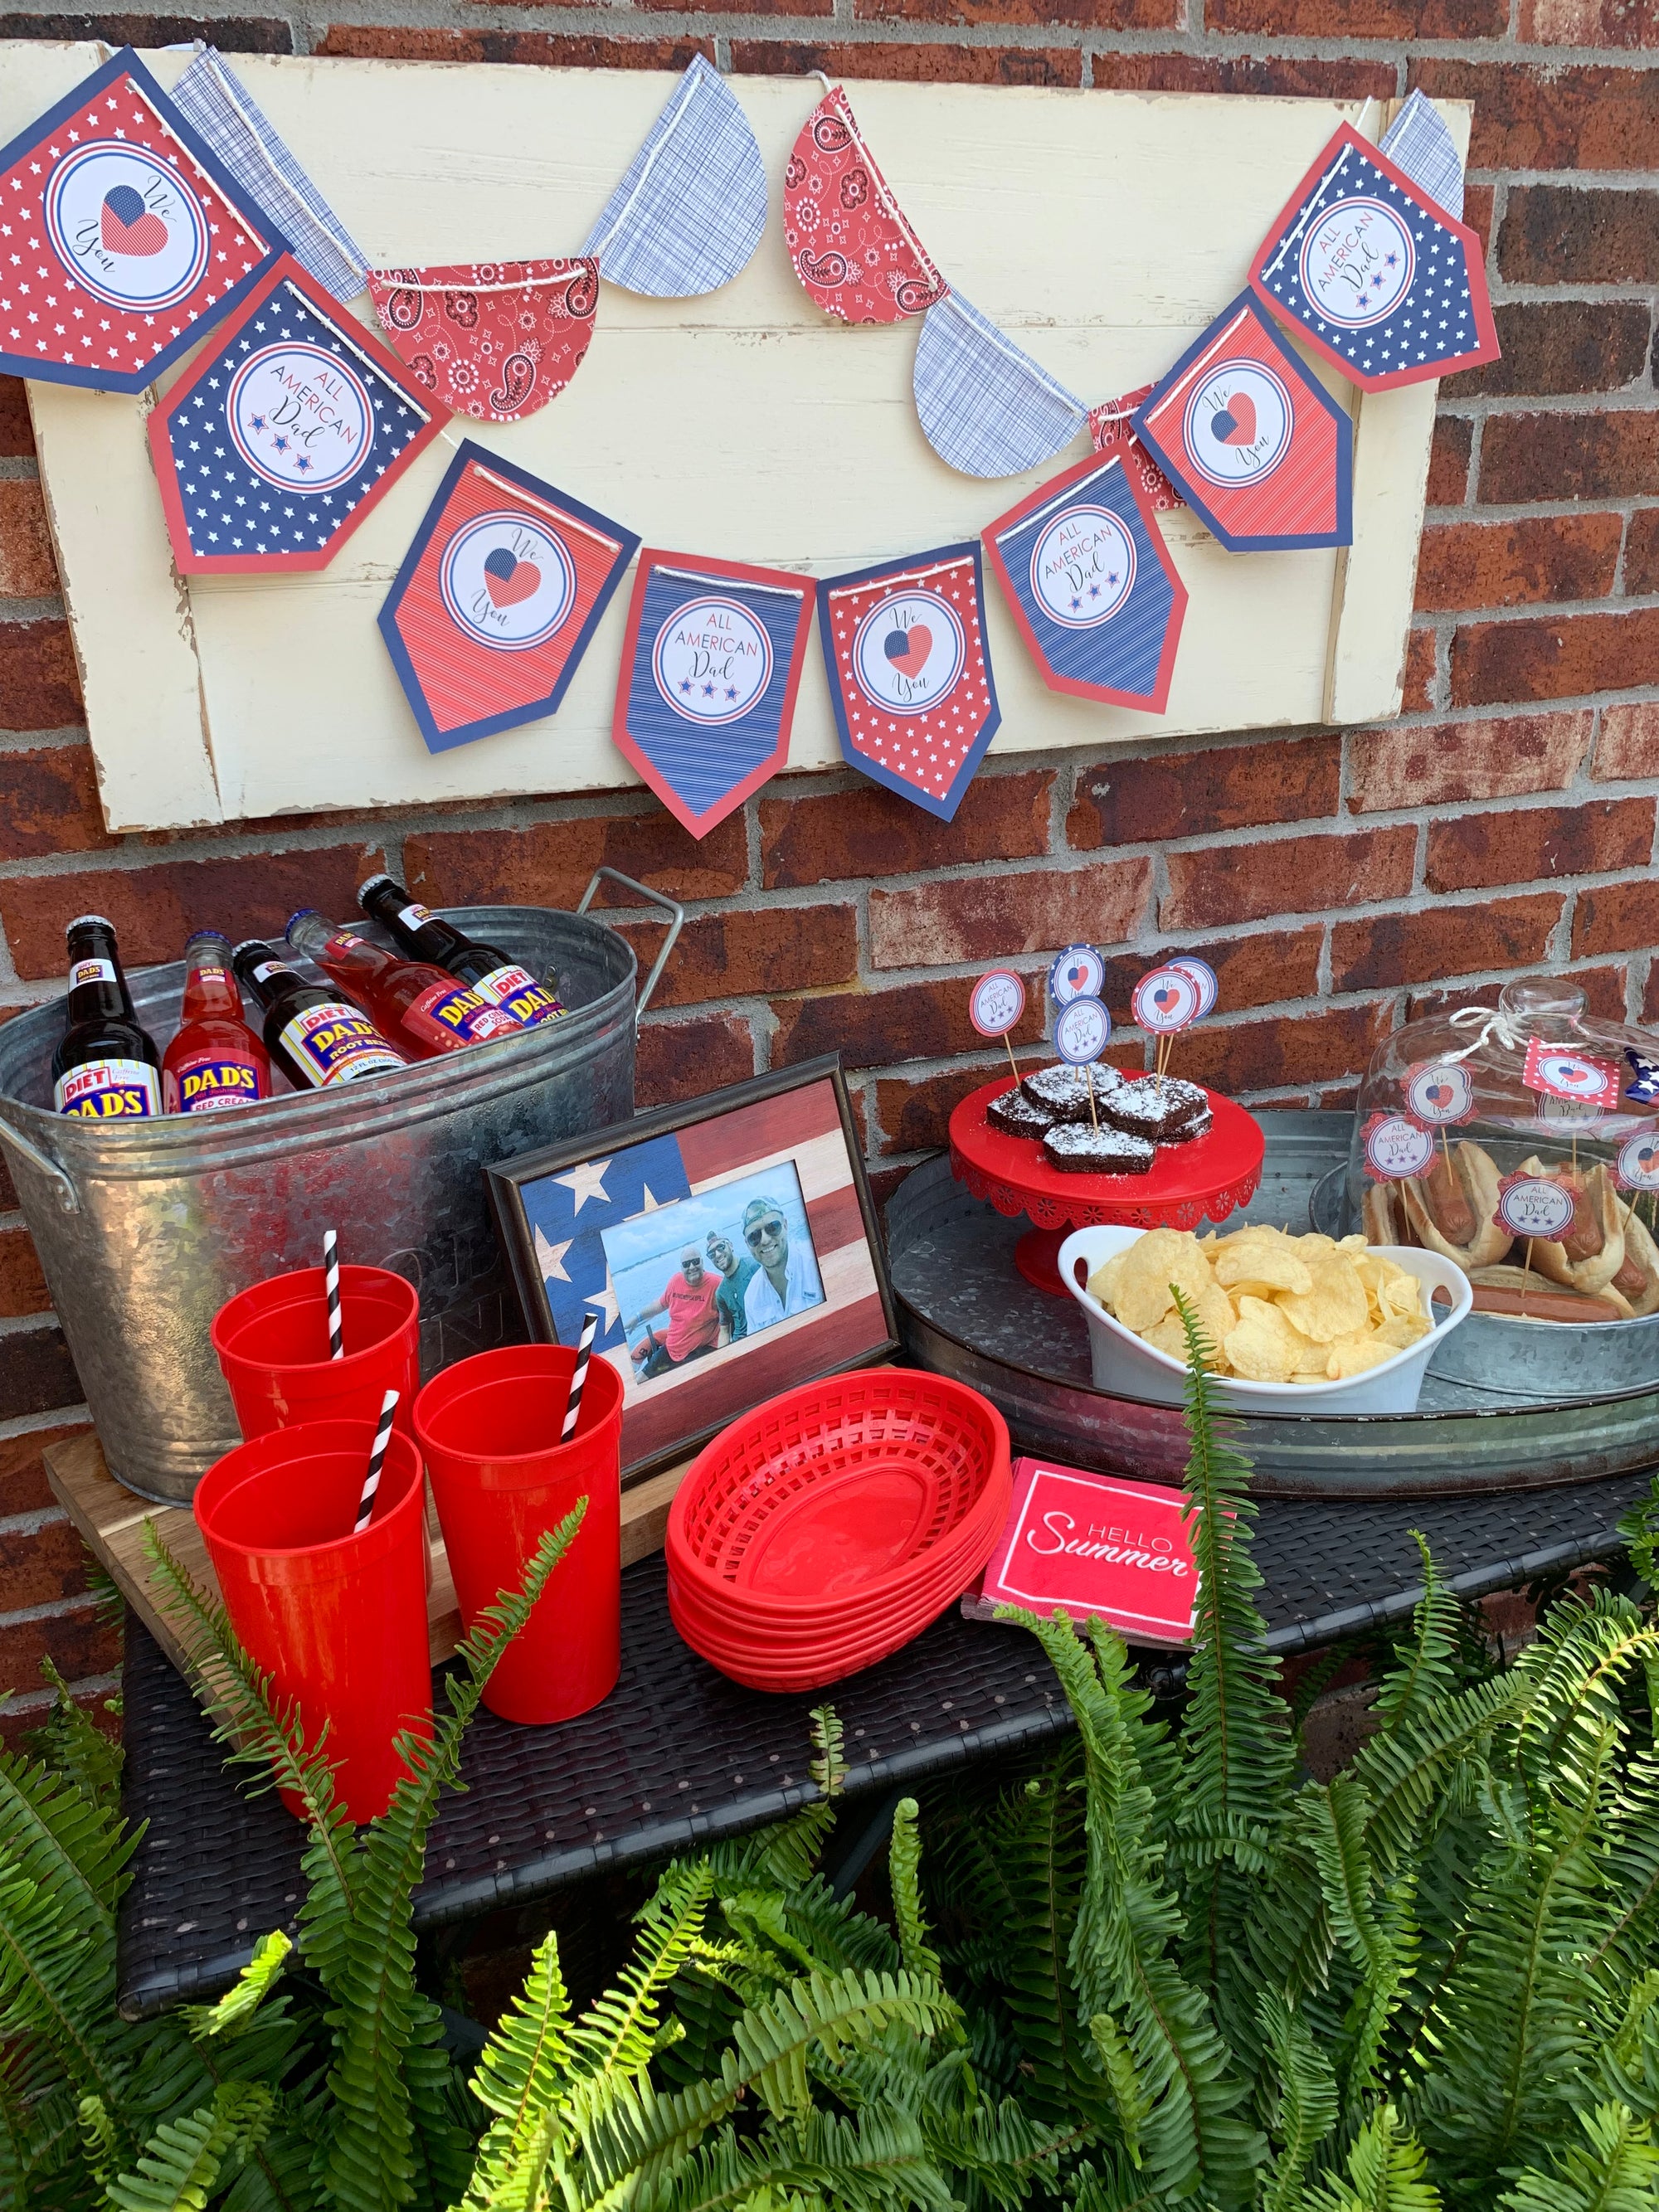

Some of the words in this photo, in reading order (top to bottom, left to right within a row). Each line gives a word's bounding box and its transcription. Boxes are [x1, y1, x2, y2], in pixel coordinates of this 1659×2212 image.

[144, 175, 177, 222] We
[72, 219, 115, 273] You
[1318, 211, 1374, 292] AMERICAN
[1319, 226, 1341, 255] ALL
[1340, 241, 1379, 293] Dad
[314, 372, 343, 401] ALL
[1202, 385, 1232, 411] We
[270, 366, 358, 445] AMERICAN
[269, 395, 325, 448] Dad
[1234, 435, 1270, 469] You
[511, 527, 544, 561] We
[1058, 523, 1082, 546] ALL
[1045, 524, 1112, 580] AMERICAN
[1064, 551, 1105, 594] Dad
[470, 589, 511, 627] You
[706, 613, 732, 630] ALL
[889, 606, 922, 630] We
[674, 630, 758, 657] AMERICAN
[688, 650, 734, 680] Dad
[892, 673, 930, 703] You
[496, 971, 528, 995] DIET
[980, 984, 1012, 1008] AMERICAN
[988, 982, 998, 993] ALL
[306, 1009, 347, 1028] DIET
[474, 1018, 489, 1031] RED
[1064, 1012, 1097, 1035] AMERICAN
[1073, 1009, 1084, 1019] ALL
[329, 1041, 362, 1060] ROOT
[66, 1070, 106, 1100] DIET
[182, 1066, 255, 1101] DAD'S
[197, 1099, 214, 1111] RED
[1378, 1131, 1423, 1145] AMERICAN
[1391, 1124, 1405, 1133] ALL
[1389, 1142, 1413, 1156] Dad
[1513, 1194, 1563, 1205] AMERICAN
[1530, 1186, 1546, 1194] ALL
[1522, 1203, 1550, 1217] Dad
[1026, 1510, 1189, 1578] Summer
[1087, 1523, 1173, 1553] HELLO
